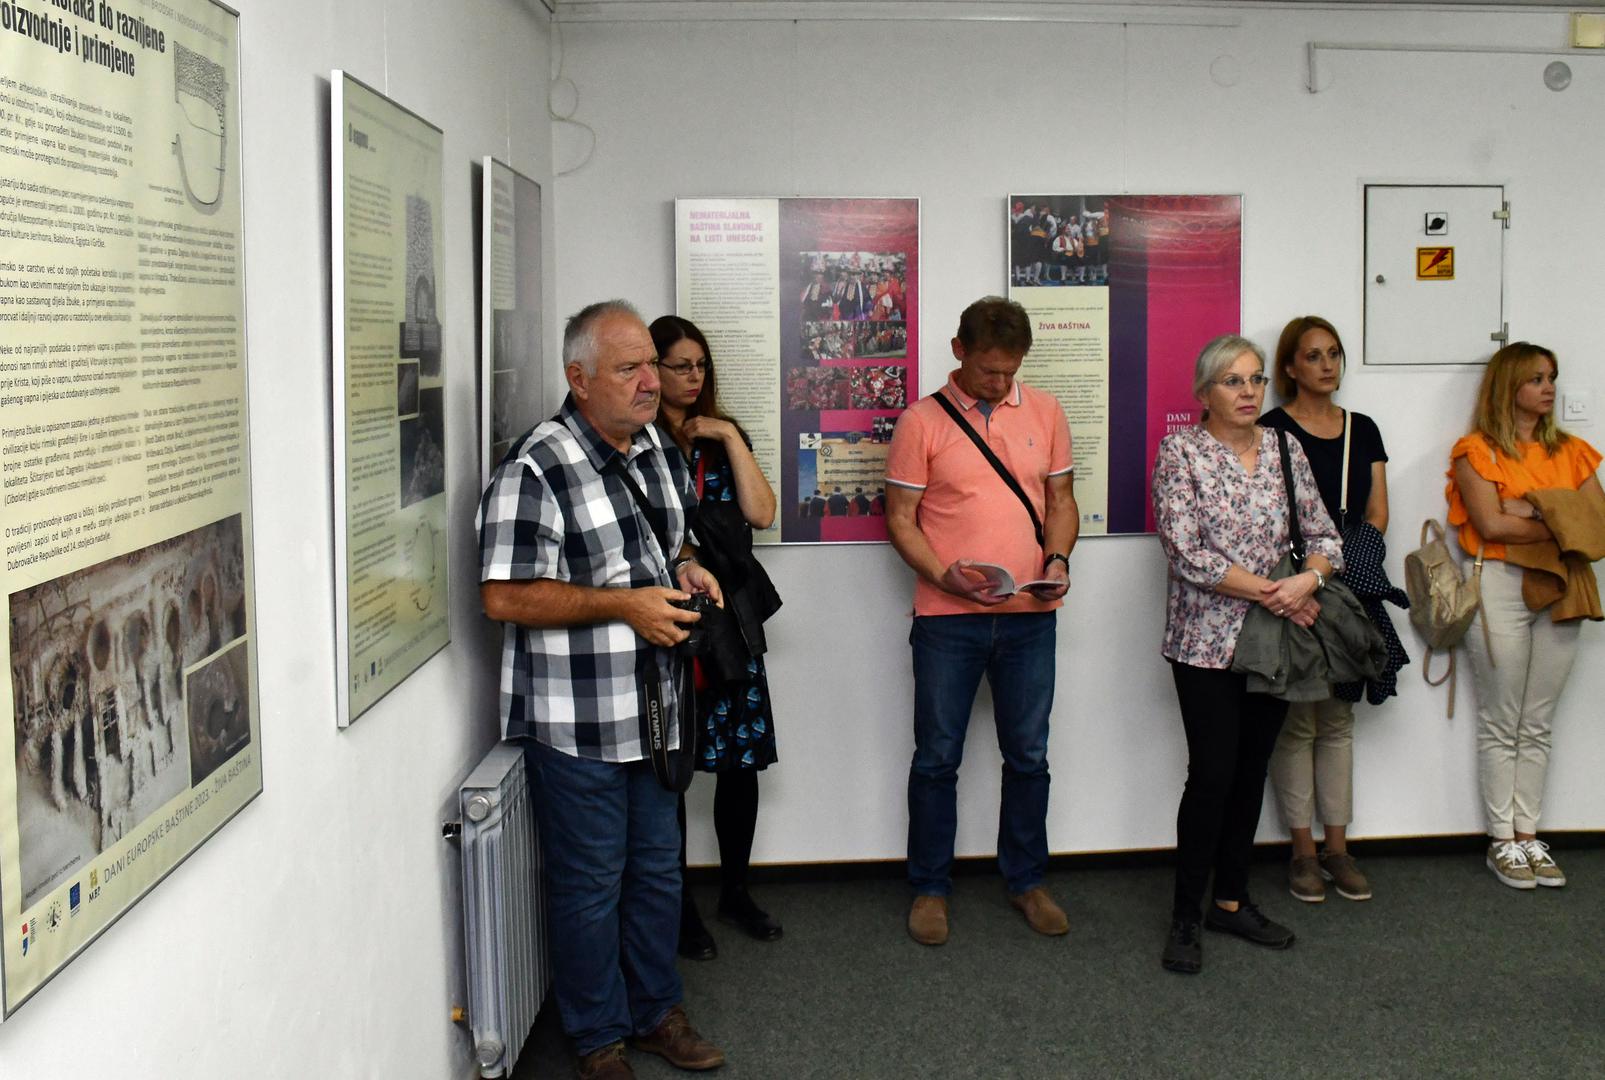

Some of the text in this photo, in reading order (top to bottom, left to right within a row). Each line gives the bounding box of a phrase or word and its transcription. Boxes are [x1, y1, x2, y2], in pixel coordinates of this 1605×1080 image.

[51, 0, 94, 22] raka
[100, 0, 113, 30] do
[117, 10, 164, 53] razvijene
[0, 0, 134, 76] oizvodnje i primjene
[14, 130, 37, 146] primjene
[40, 139, 55, 150] vapna
[20, 147, 33, 159] može
[35, 151, 59, 166] protegnuti
[27, 182, 38, 192] sada
[690, 222, 720, 230] BAŠTINA
[26, 263, 44, 273] carstvo
[47, 265, 55, 273] već
[57, 265, 63, 274] od
[65, 266, 78, 277] svojih
[81, 267, 99, 278] početaka
[19, 279, 28, 288] kao
[30, 280, 51, 289] vezivnim
[53, 281, 80, 292] materijalom
[15, 295, 104, 308] kao sastavnog dijela žbuke, primjena
[37, 312, 51, 322] razvoj
[53, 314, 68, 322] upravo
[14, 345, 21, 353] od
[24, 344, 46, 355] najranijih
[49, 343, 70, 354] podataka
[77, 342, 95, 353] primjeni
[0, 362, 18, 371] donosi
[32, 360, 46, 369] rimski
[48, 359, 66, 368] arhitekt
[71, 358, 88, 369] graditelj
[0, 378, 12, 390] prije
[14, 377, 30, 388] Krista,
[31, 376, 39, 387] koji
[41, 375, 50, 386] piše
[56, 376, 72, 385] vapnu,
[73, 372, 91, 382] odnosno
[0, 394, 22, 407] gašenog
[23, 395, 38, 404] vapna
[42, 390, 58, 402] pijeska
[66, 388, 88, 400] dodavanje
[1167, 413, 1190, 422] DANI
[2, 426, 25, 440] Primjena
[26, 424, 40, 434] žbuke
[46, 420, 69, 433] opisanom
[71, 417, 86, 428] sastavu
[3, 442, 28, 457] civilizacije
[29, 440, 39, 452] koju
[42, 438, 56, 448] rimski
[58, 434, 78, 448] graditelji
[3, 460, 20, 474] brojne
[24, 456, 42, 467] ostatke
[4, 474, 27, 488] lokaliteta
[28, 488, 38, 501] gdje
[12, 522, 31, 538] tradiciji
[33, 514, 61, 532] proizvodnje
[63, 513, 76, 524] vapna
[6, 538, 31, 556] povijesni
[34, 534, 48, 548] zapisi
[52, 531, 58, 541] od
[61, 527, 72, 540] kojih
[83, 520, 95, 532] među
[98, 516, 111, 529] starije
[7, 553, 37, 570] Dubrovačke
[39, 545, 62, 562] Republike
[77, 535, 94, 550] stoljeća
[650, 700, 662, 750] OLYMPUS
[104, 855, 125, 883] DANI
[126, 824, 164, 865] EUROPSKE
[165, 802, 193, 833] BAŠTINE
